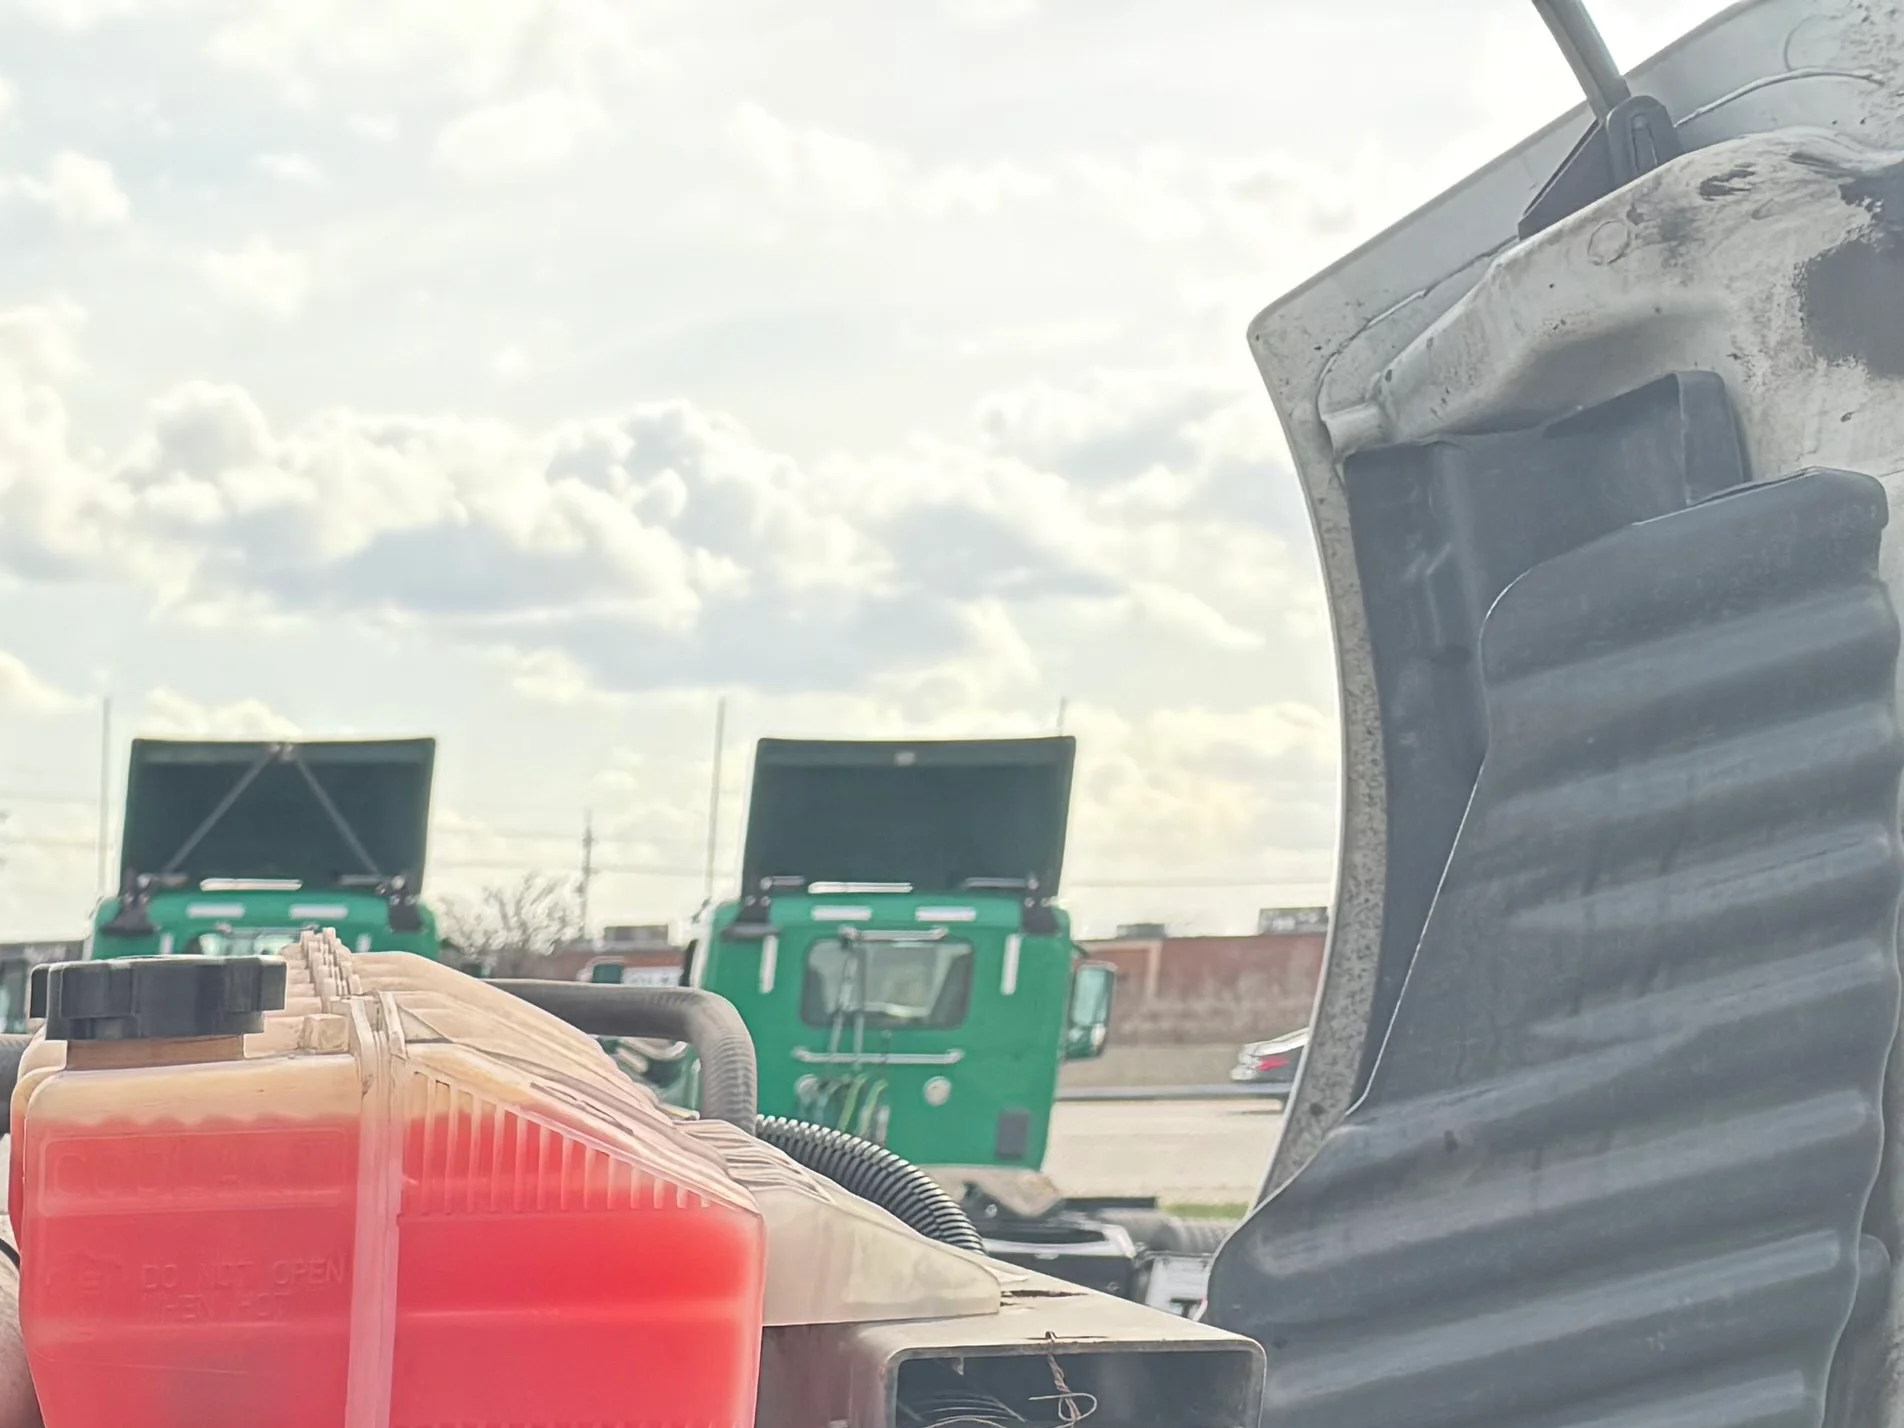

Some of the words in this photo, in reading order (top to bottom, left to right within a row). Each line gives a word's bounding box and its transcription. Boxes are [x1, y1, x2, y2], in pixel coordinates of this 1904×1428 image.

[141, 1263, 179, 1290] DO
[198, 1259, 255, 1291] NOT
[271, 1253, 347, 1287] OPEN
